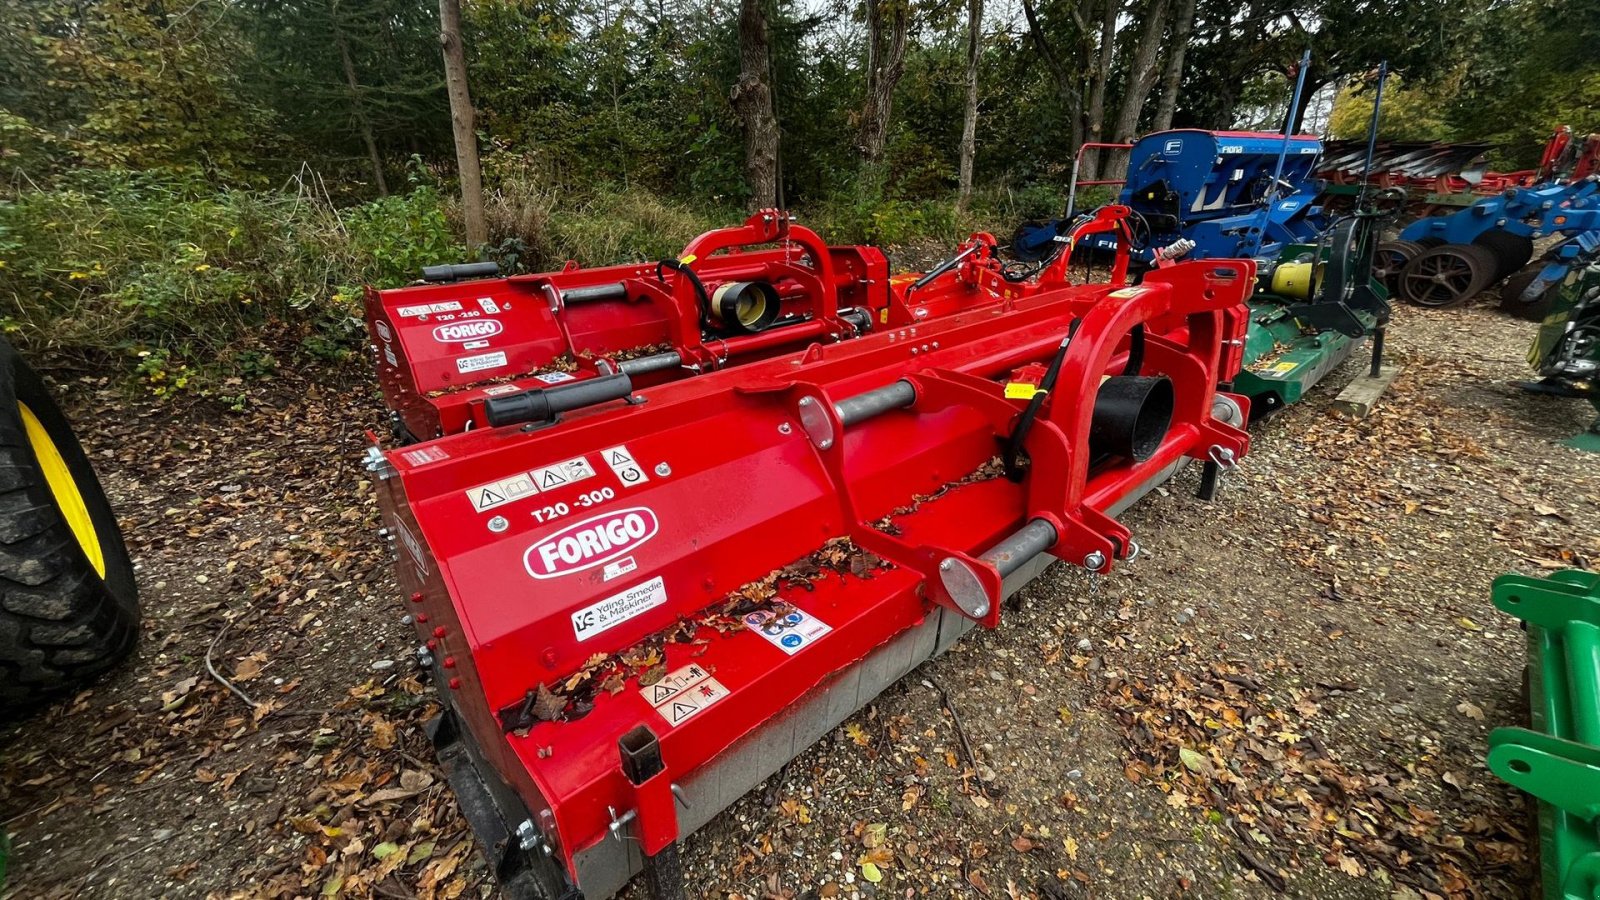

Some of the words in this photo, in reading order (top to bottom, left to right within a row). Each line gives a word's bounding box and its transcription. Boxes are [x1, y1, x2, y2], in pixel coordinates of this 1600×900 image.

[440, 321, 496, 340] FORIGO
[530, 502, 569, 523] T20
[573, 487, 615, 507] -300
[537, 513, 646, 573] FORIGO
[596, 598, 625, 614] Yding
[626, 581, 662, 602] Smedie
[599, 613, 608, 622] &
[609, 593, 653, 618] Maskiner
